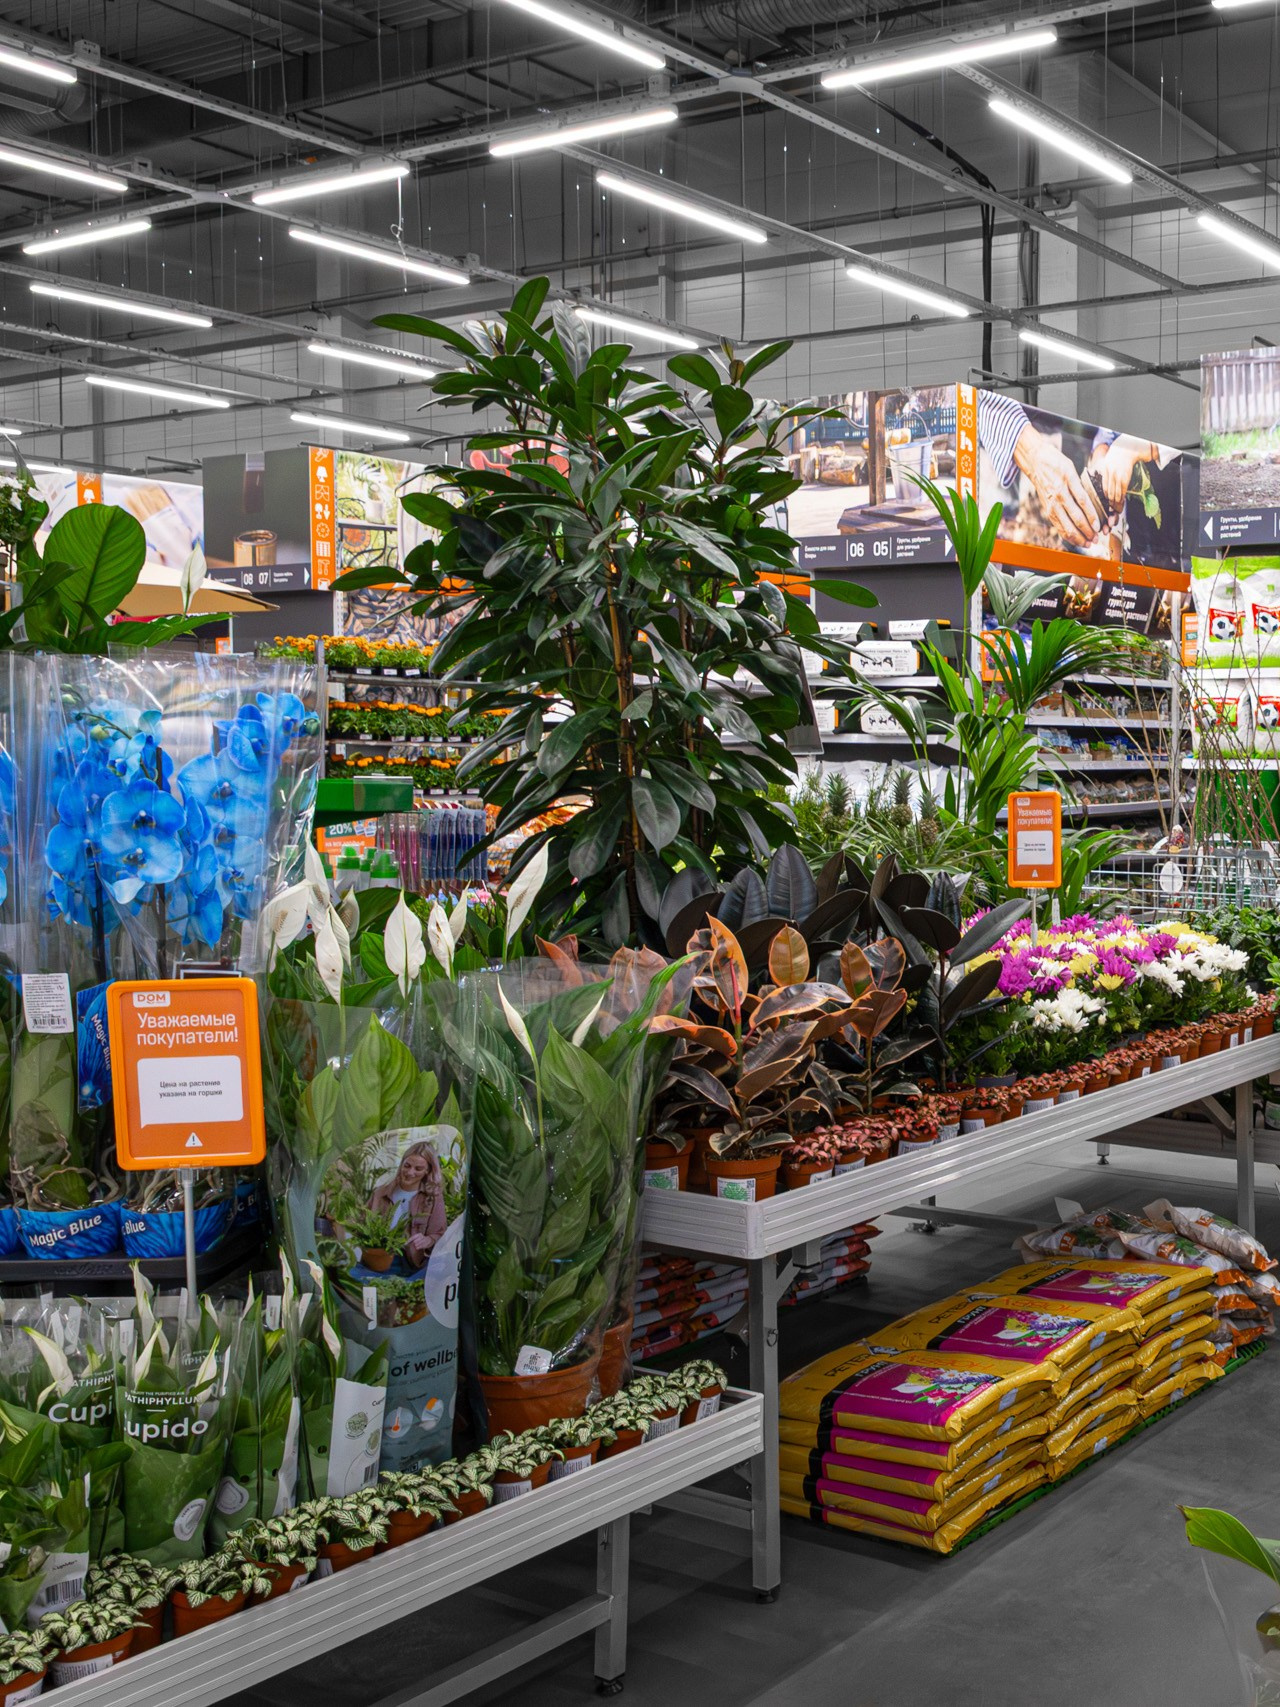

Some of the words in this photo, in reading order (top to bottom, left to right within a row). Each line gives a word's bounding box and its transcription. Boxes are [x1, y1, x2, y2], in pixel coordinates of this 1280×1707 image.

[849, 542, 865, 558] 06
[873, 541, 889, 557] 05
[243, 573, 254, 585] 08
[258, 572, 269, 585] 07
[1018, 808, 1052, 817] Уважаемые
[329, 823, 352, 836] 20%
[137, 993, 166, 1004] DOM
[137, 1012, 236, 1028] Уважаемые
[137, 1026, 239, 1048] покупатели!
[160, 1081, 177, 1089] Цена
[159, 1091, 186, 1099] указана
[198, 1089, 223, 1098] горшке
[29, 1227, 67, 1247] Magic
[69, 1213, 102, 1236] Blue
[125, 1219, 146, 1236] Blue
[391, 1360, 410, 1377] of
[48, 1395, 114, 1425] Cupi
[124, 1416, 208, 1444] upido
